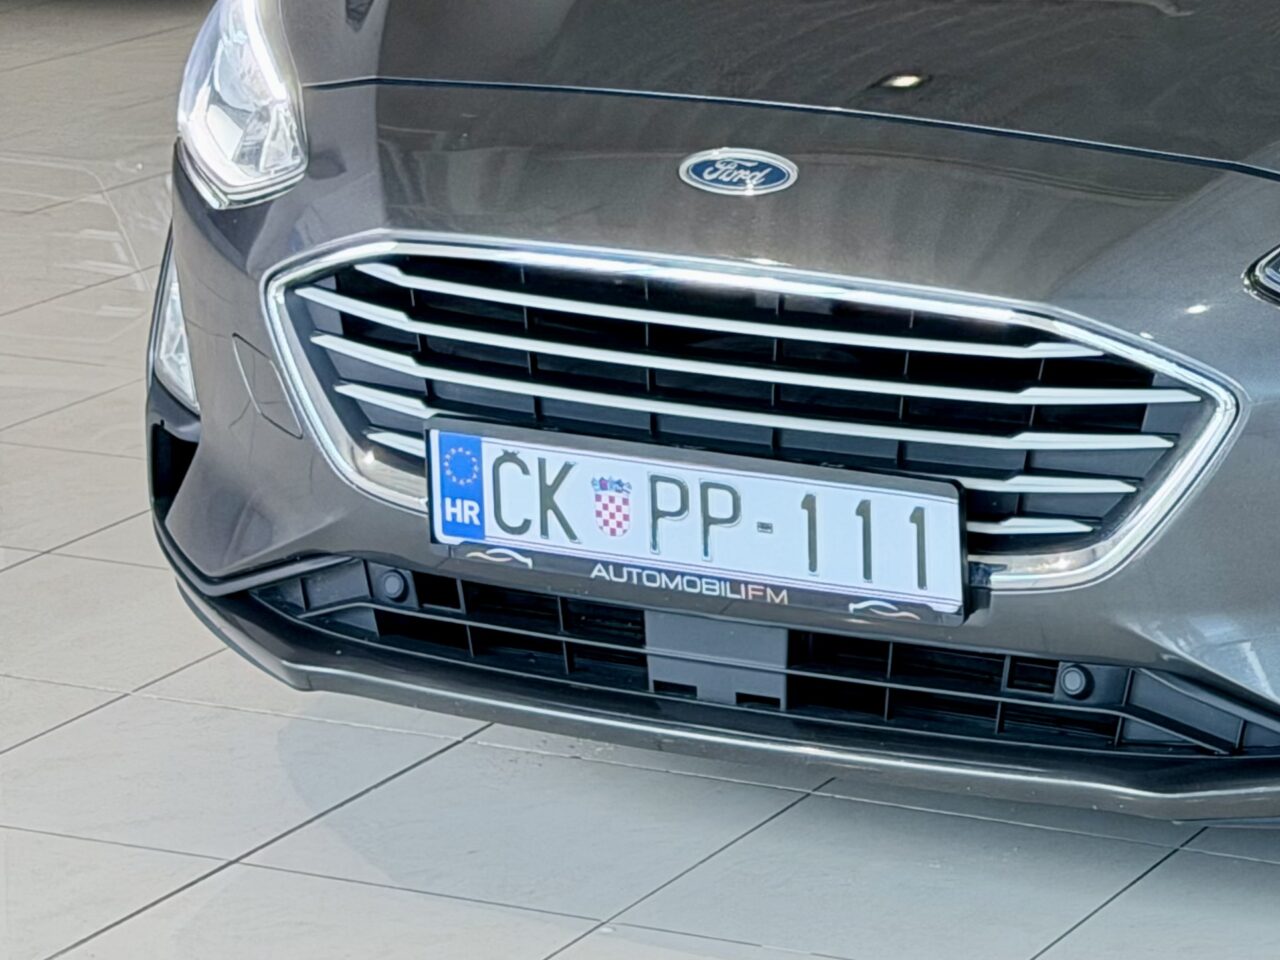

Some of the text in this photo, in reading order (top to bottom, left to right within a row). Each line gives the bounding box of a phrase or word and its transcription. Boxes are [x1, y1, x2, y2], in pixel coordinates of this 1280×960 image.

[702, 159, 773, 186] Ford
[444, 497, 482, 526] HR
[590, 562, 790, 606] AUTOMOBILIFM
